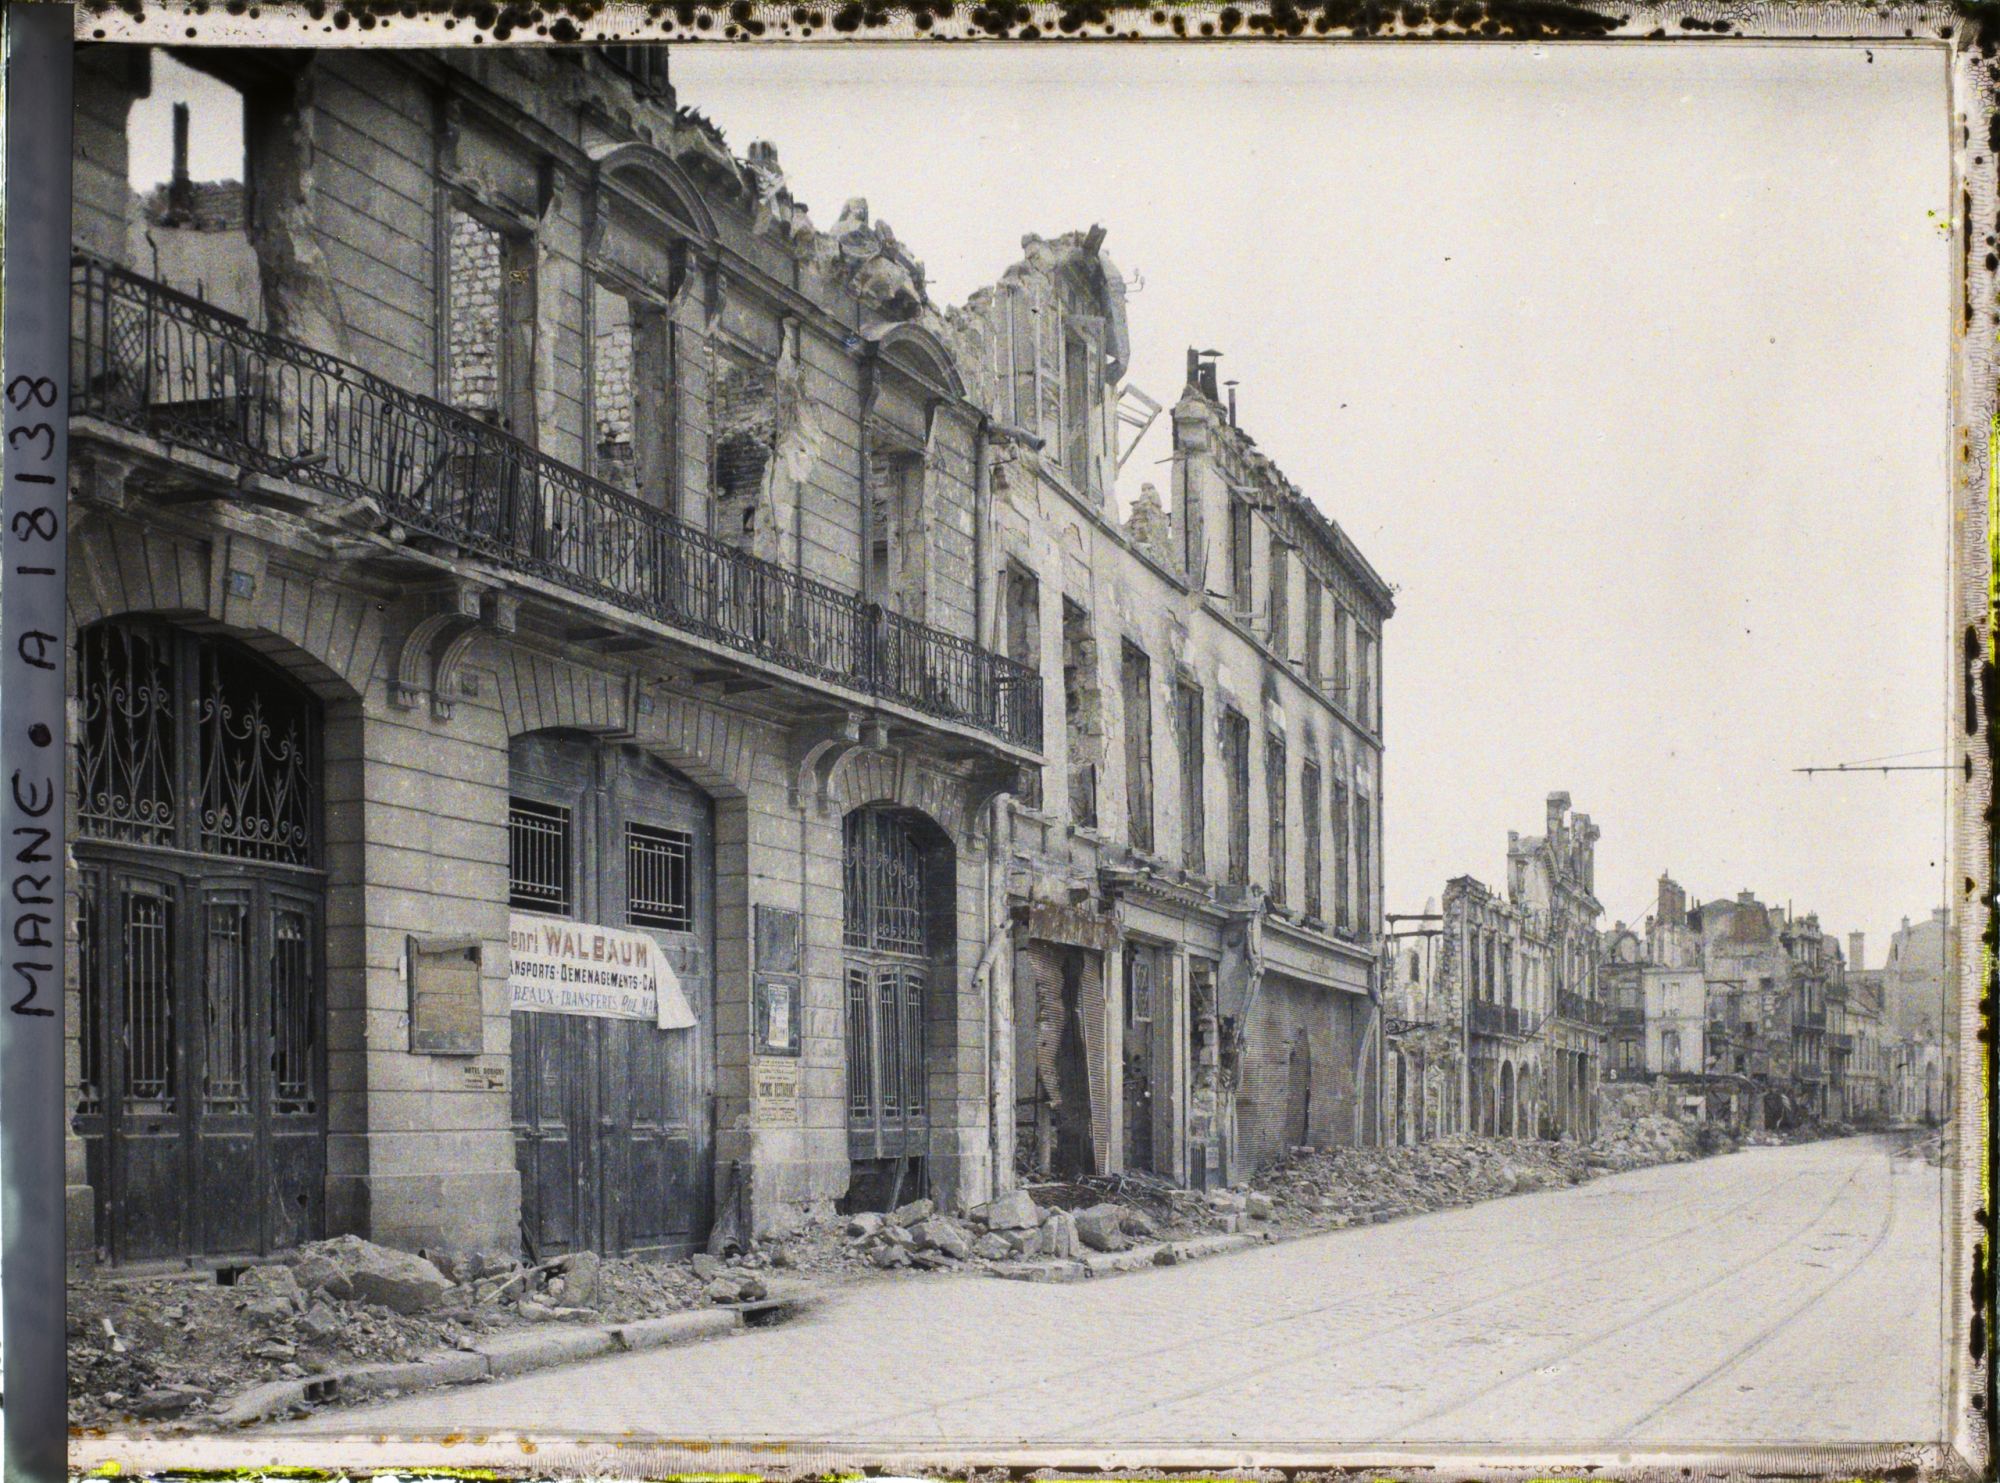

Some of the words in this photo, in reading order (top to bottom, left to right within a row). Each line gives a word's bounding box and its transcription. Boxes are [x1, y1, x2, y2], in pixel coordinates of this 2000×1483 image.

[6, 374, 58, 575] 18138
[18, 629, 58, 670] A
[11, 768, 55, 1017] MARNE
[511, 927, 539, 954] enri
[542, 924, 648, 968] WALBAUM
[510, 959, 556, 980] ANSPORTS
[560, 963, 638, 991] DEMENAGEMENTS
[511, 985, 555, 1005] REAUX
